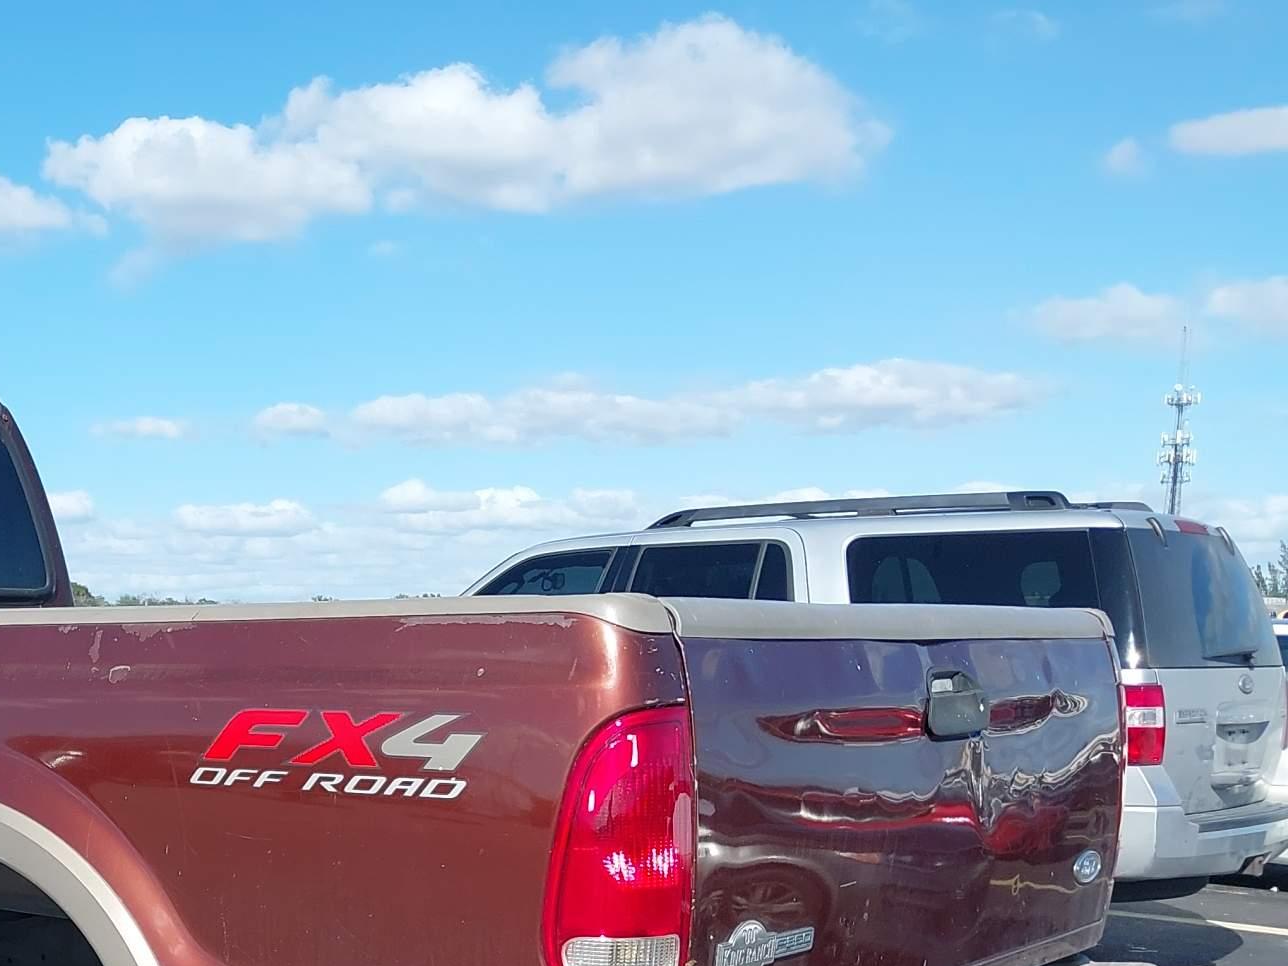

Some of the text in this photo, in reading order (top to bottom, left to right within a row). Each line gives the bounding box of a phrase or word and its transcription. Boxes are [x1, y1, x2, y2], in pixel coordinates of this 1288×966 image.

[202, 708, 485, 771] FX4
[190, 766, 468, 799] OFF ROAD
